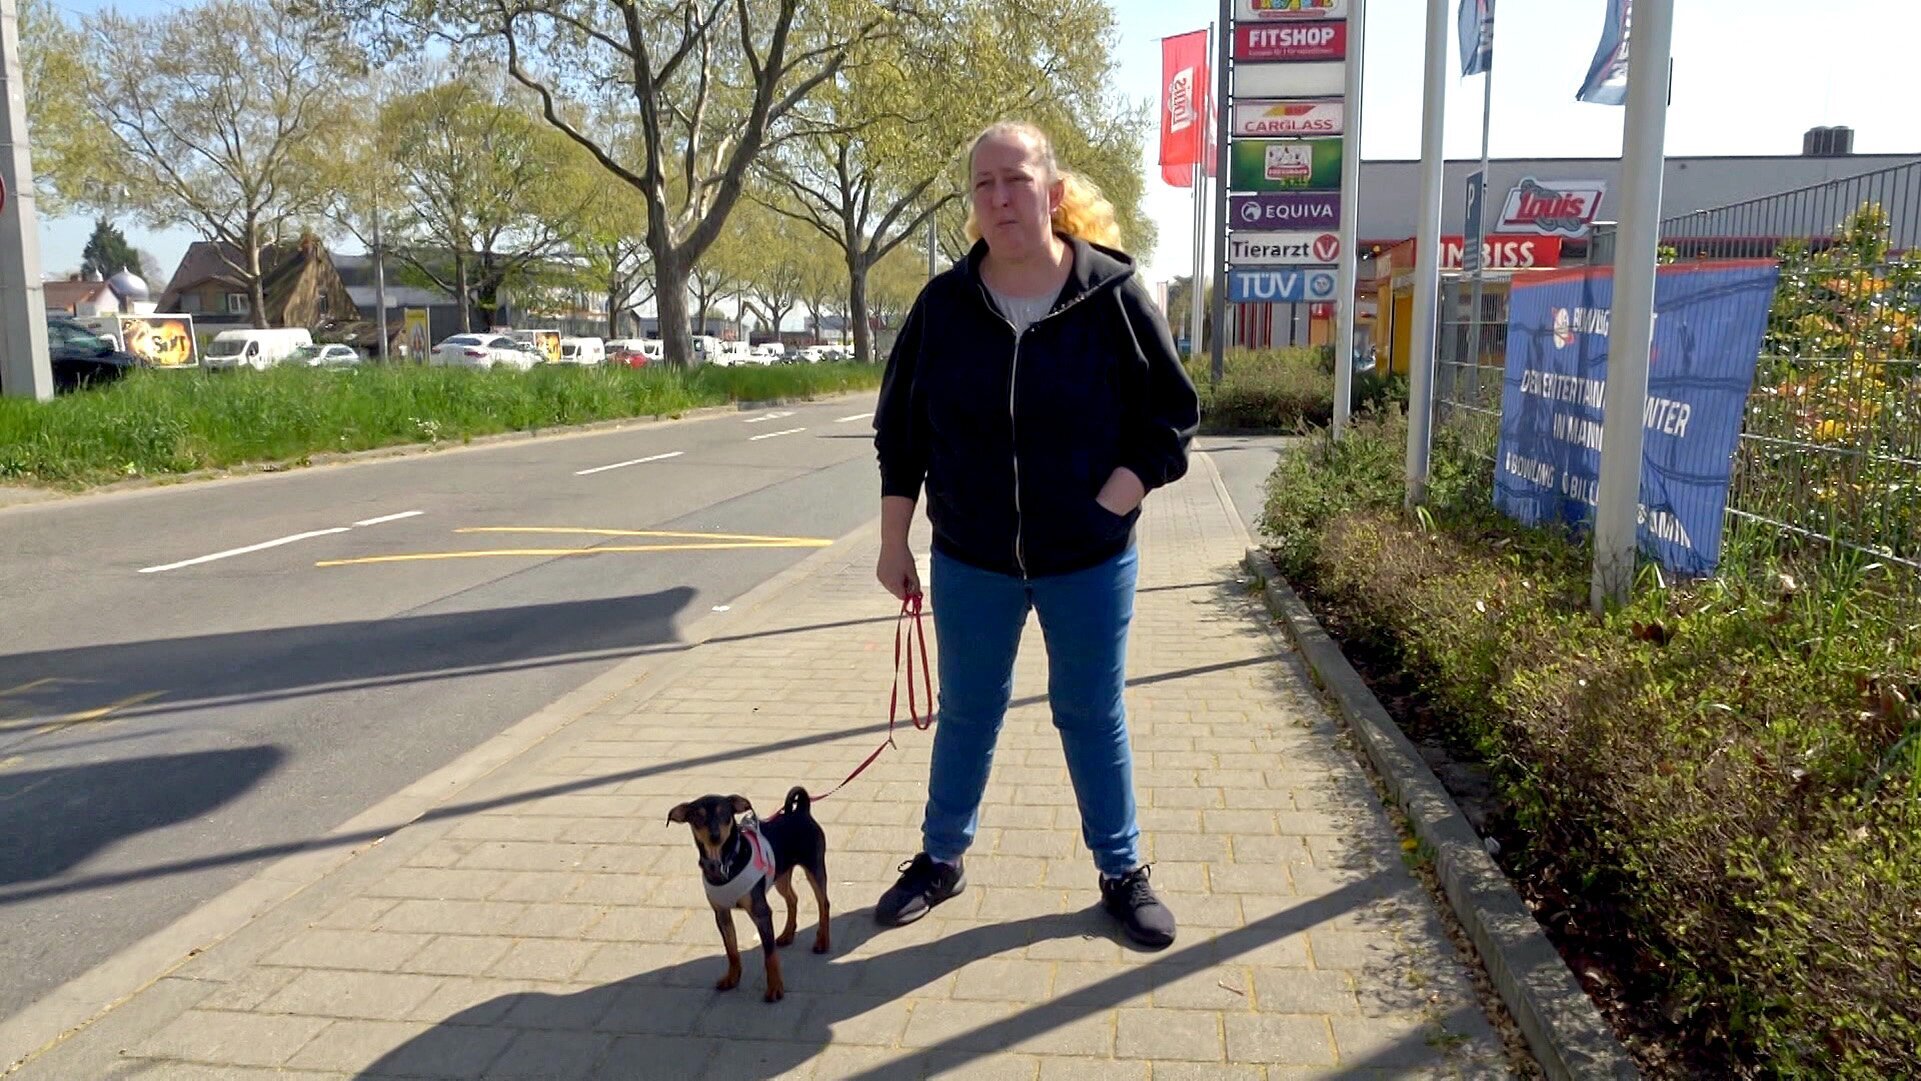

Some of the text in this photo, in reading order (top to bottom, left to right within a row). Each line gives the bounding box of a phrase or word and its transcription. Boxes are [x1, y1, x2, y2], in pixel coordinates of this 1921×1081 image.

[1249, 27, 1335, 48] FITSHOP
[1244, 119, 1334, 133] CARGLASS
[1265, 204, 1334, 220] EQUIVA
[1467, 183, 1476, 220] P
[1516, 191, 1586, 218] Louis
[1232, 240, 1310, 258] Tierarzt
[1438, 241, 1536, 269] IMBISS
[1236, 272, 1298, 299] TÜV
[1542, 373, 1606, 410] ENTERTAIN
[1643, 396, 1691, 438] NTER
[1566, 415, 1604, 451] MANN
